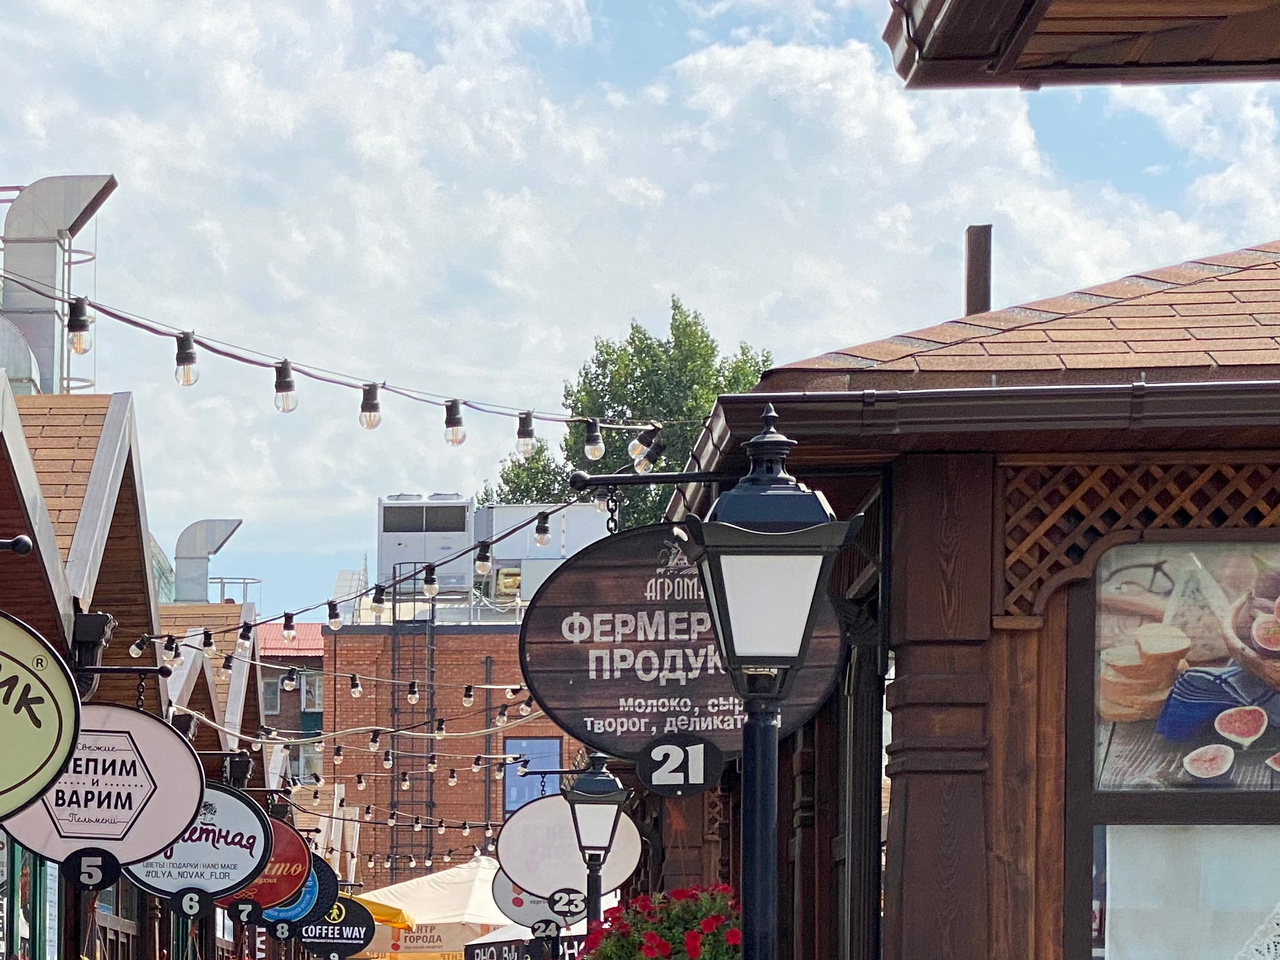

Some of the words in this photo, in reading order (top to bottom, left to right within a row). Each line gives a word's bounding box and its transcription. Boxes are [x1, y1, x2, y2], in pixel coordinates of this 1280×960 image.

[562, 611, 710, 644] ФЕРМЕР
[588, 645, 725, 686] ПРОДУК
[619, 697, 699, 715] молоко,
[584, 717, 657, 736] творог,
[650, 743, 705, 785] 21
[55, 789, 132, 810] ВАРИМ
[69, 813, 117, 824] Пельмени
[80, 857, 103, 884] 5
[182, 893, 199, 915] 6
[554, 893, 585, 912] 23
[238, 904, 252, 922] 7
[276, 924, 289, 938] 8
[302, 925, 340, 938] COFFEE
[342, 926, 366, 938] WAY
[534, 922, 558, 937] 24
[404, 935, 442, 944] ГОРОДА
